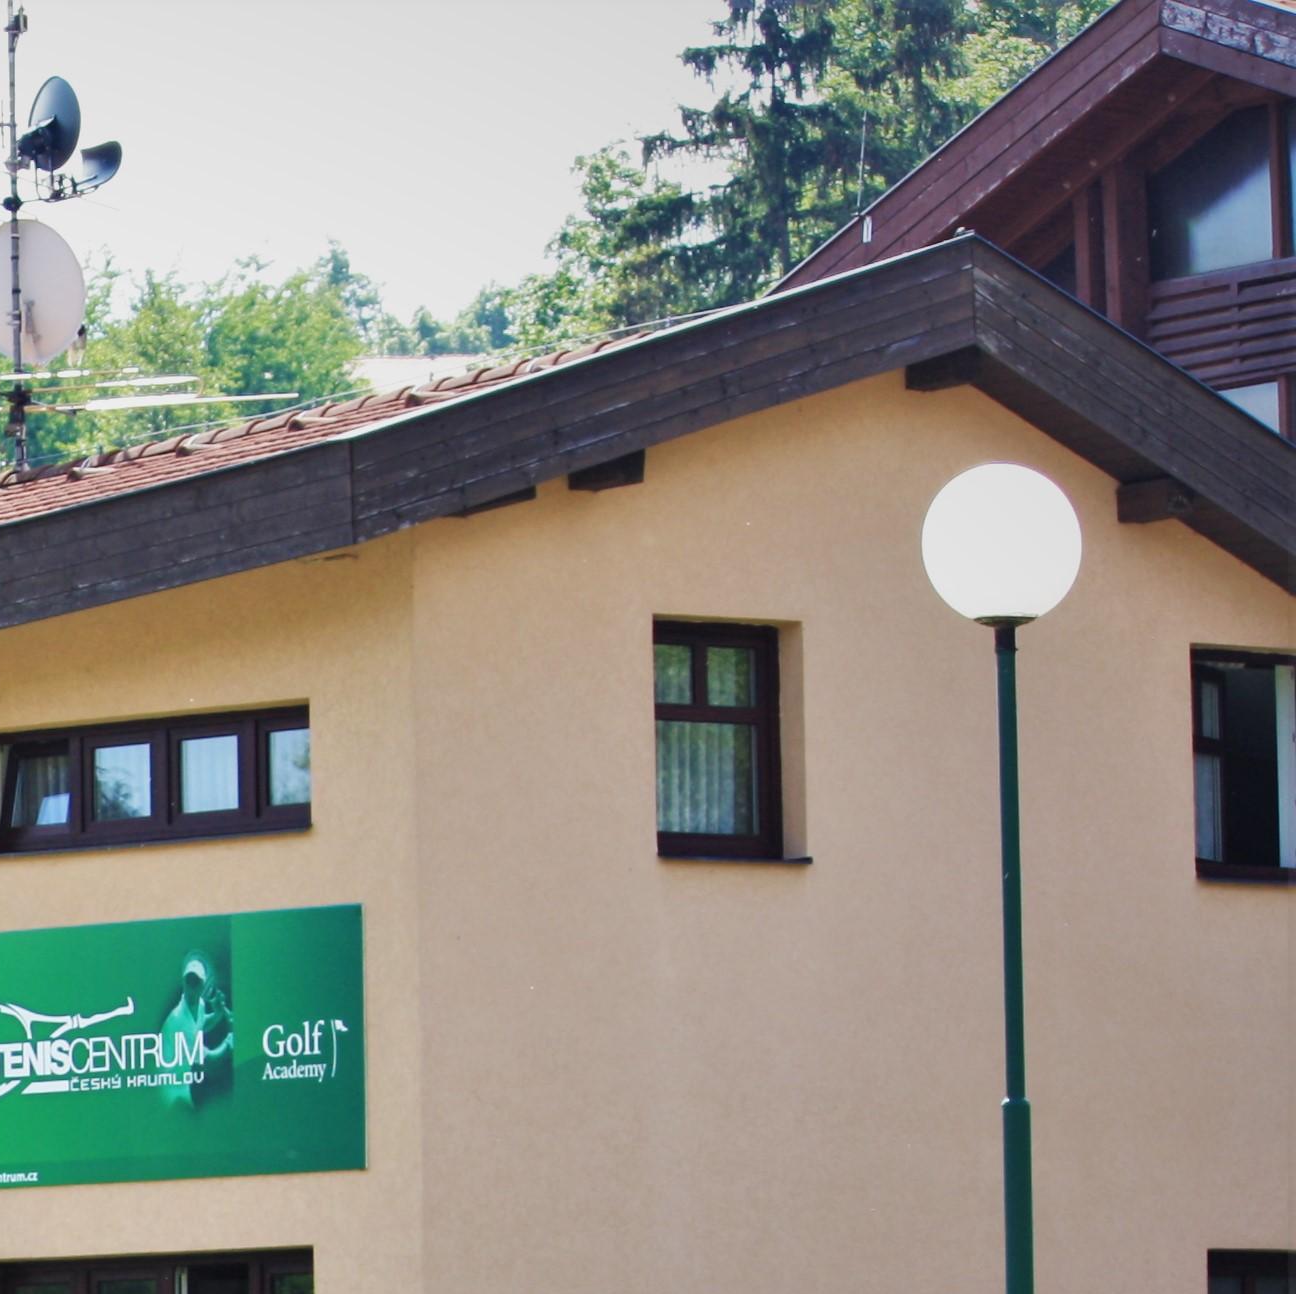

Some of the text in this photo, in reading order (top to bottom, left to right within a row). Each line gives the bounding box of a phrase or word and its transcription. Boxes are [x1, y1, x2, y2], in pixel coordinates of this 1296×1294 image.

[262, 1019, 325, 1058] Golf
[69, 1071, 205, 1092] ČESKÝ KRUMLOV
[262, 1060, 327, 1082] Academy
